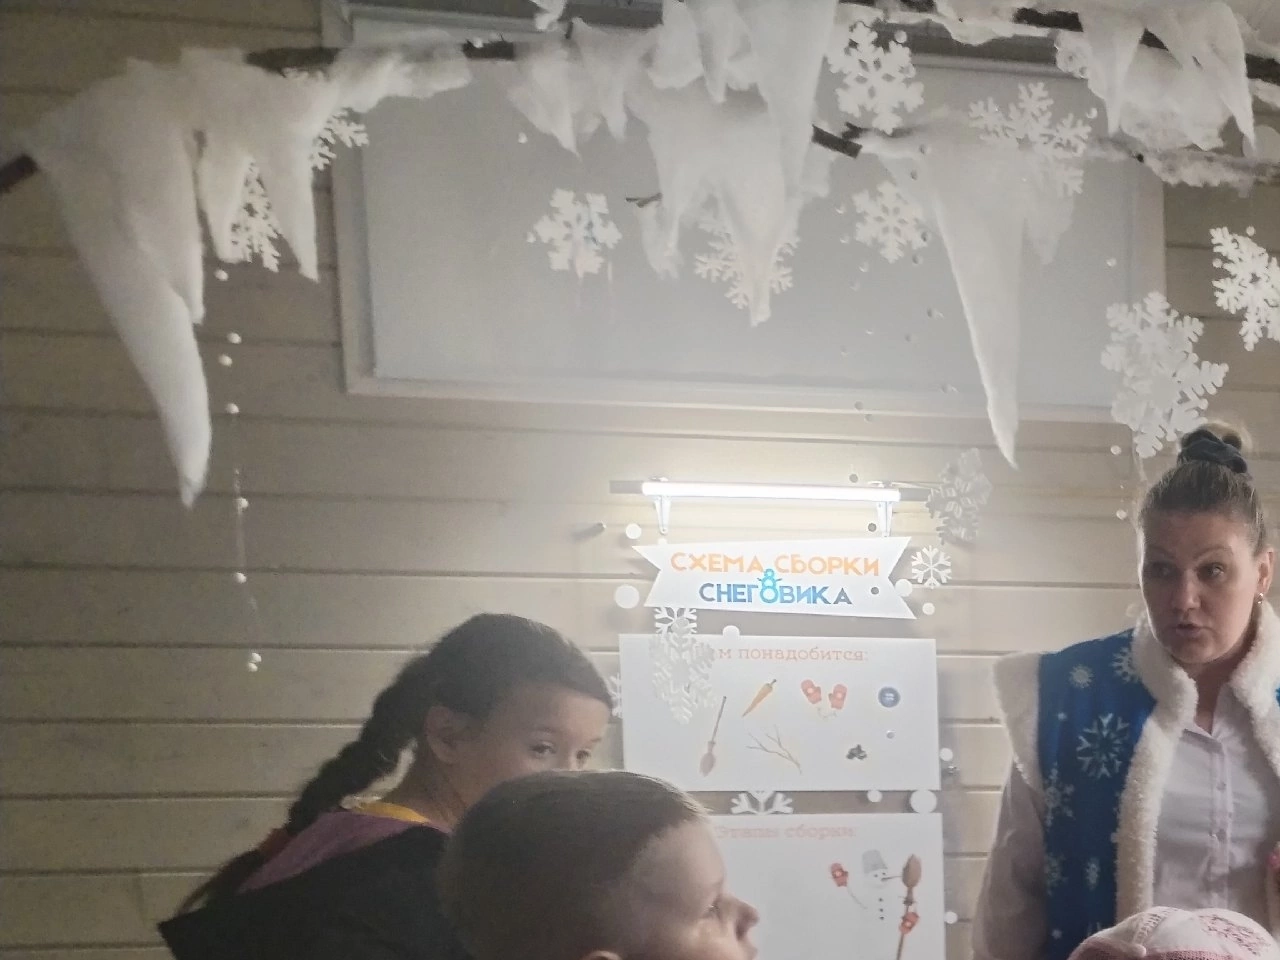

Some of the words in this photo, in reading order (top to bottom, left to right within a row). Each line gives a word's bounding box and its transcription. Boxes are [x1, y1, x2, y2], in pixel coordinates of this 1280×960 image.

[670, 552, 764, 573] СХЕМА
[774, 554, 879, 576] СБОРКИ
[698, 570, 853, 605] СНЕГОВИКА
